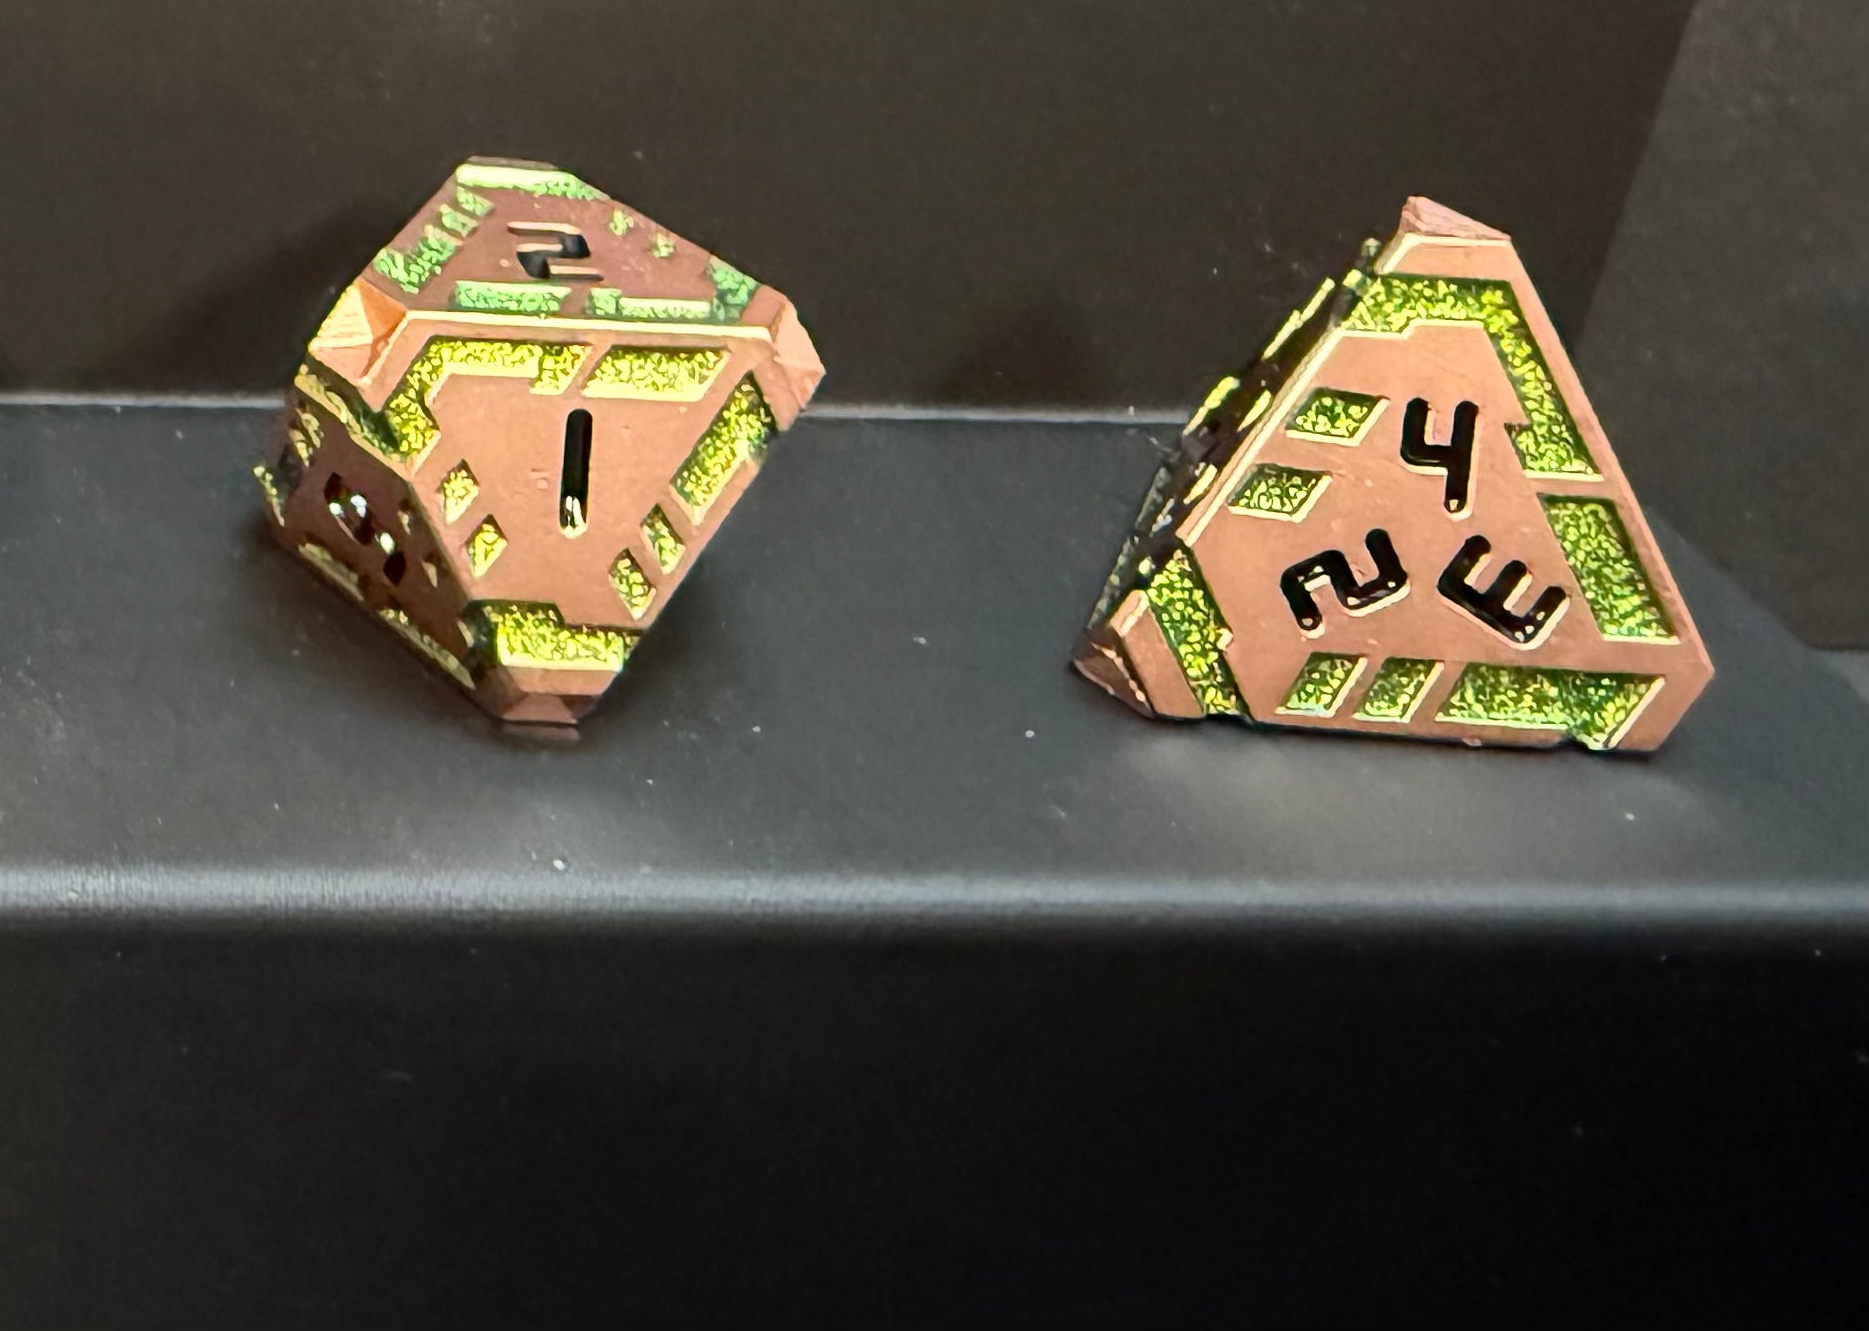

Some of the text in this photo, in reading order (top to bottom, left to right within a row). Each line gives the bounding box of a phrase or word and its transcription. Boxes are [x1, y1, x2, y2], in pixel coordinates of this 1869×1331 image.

[507, 221, 604, 282] 2
[558, 408, 593, 538] 1
[1399, 396, 1480, 520] 4
[1281, 528, 1411, 638] 2
[1436, 534, 1572, 650] 3
